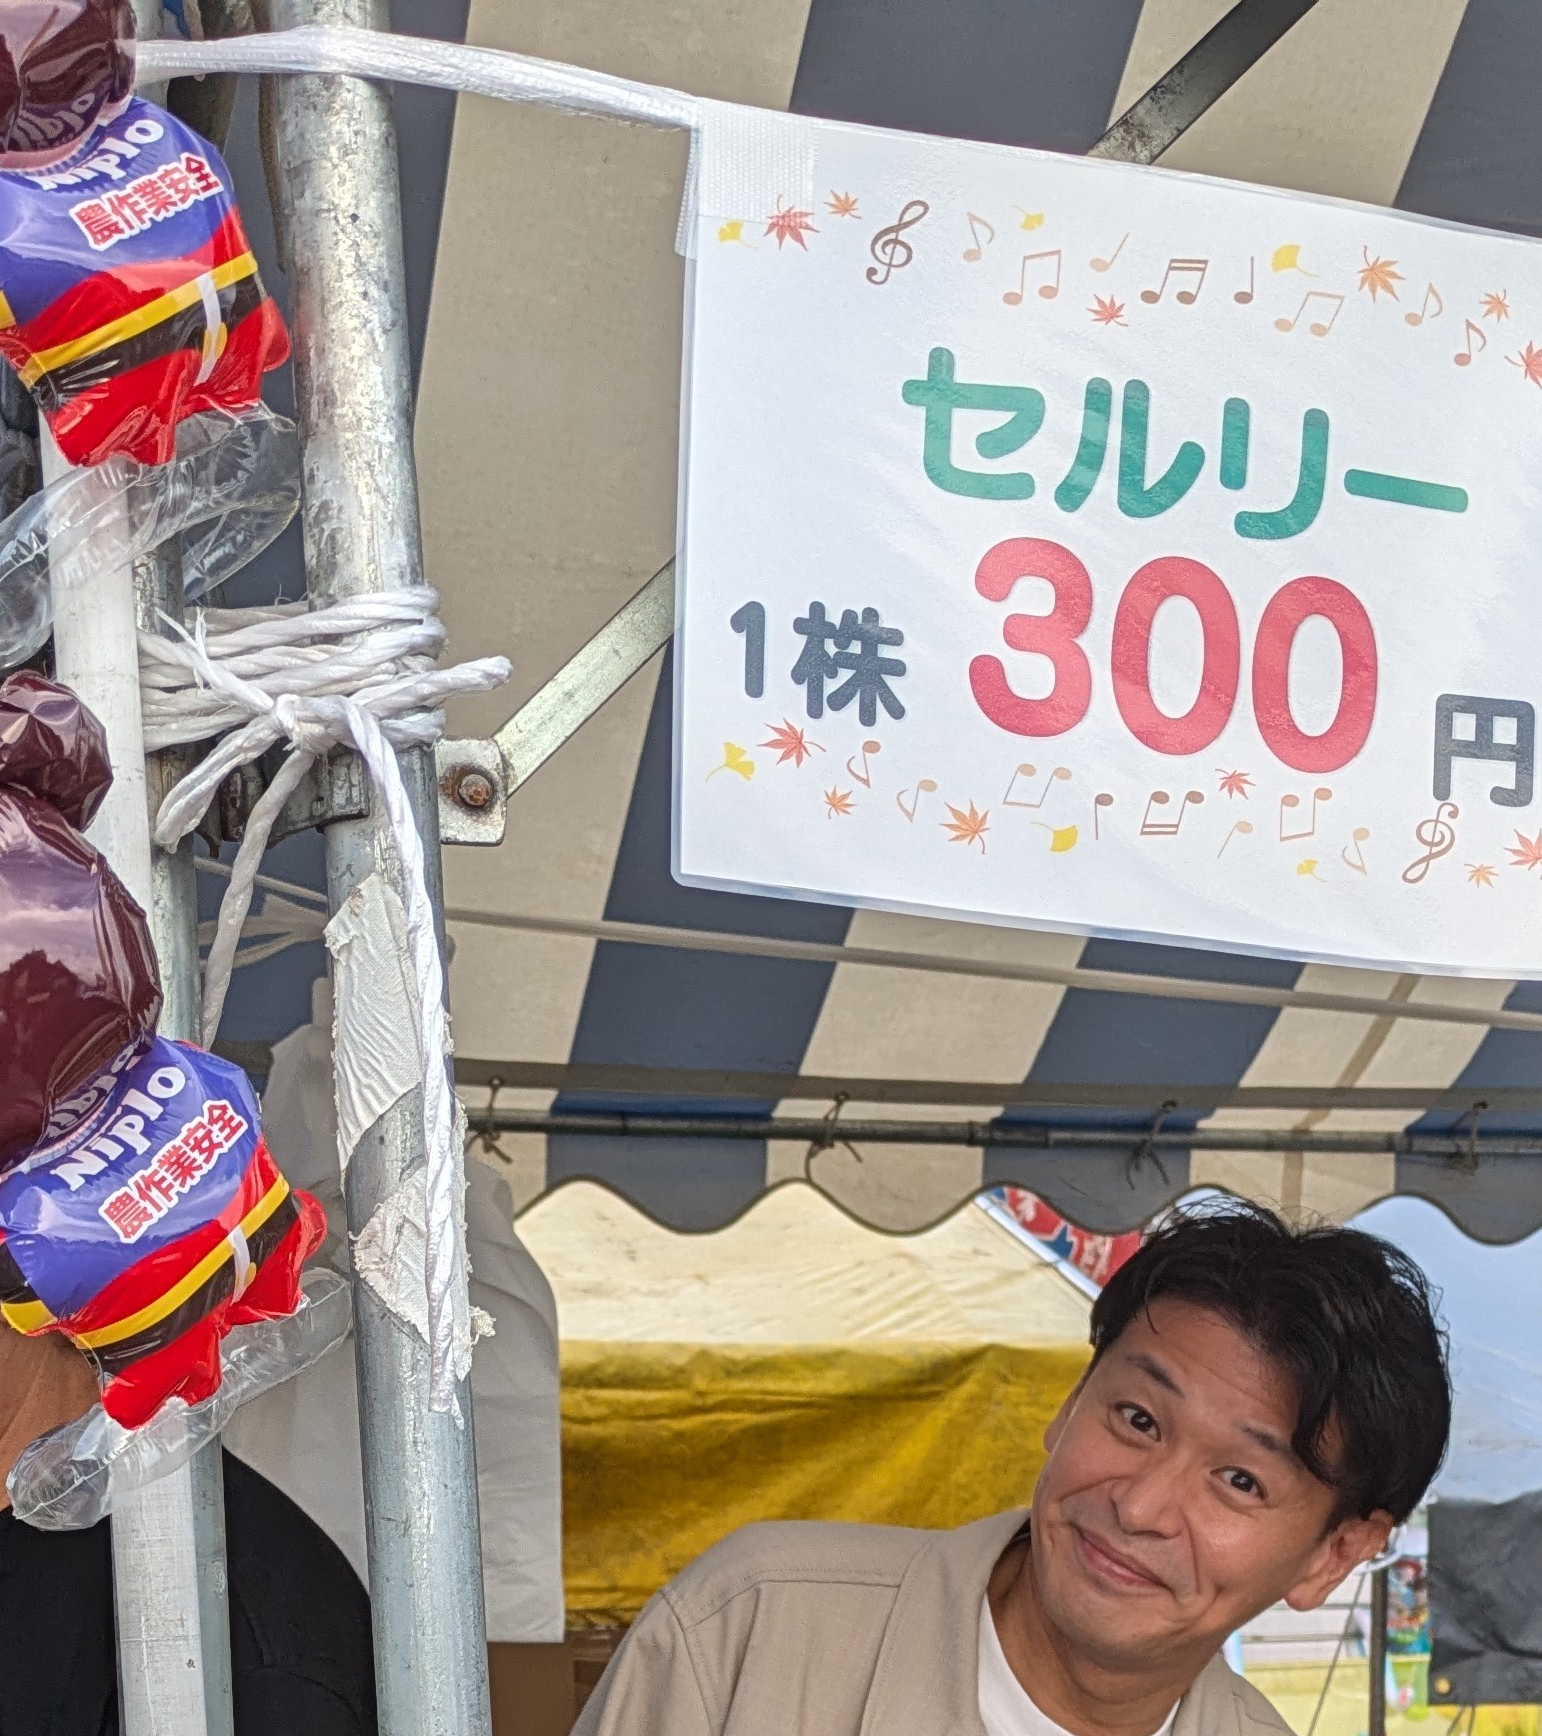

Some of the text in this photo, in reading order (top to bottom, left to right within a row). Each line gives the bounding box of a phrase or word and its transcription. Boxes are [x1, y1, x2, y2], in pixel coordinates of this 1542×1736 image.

[26, 119, 164, 190] Niplo
[70, 153, 223, 250] 農作業安全
[901, 346, 1469, 541] セルリー
[729, 537, 1536, 807] 1株 300 円
[50, 1066, 186, 1191] Niplo
[99, 1100, 248, 1243] 農作業安全
